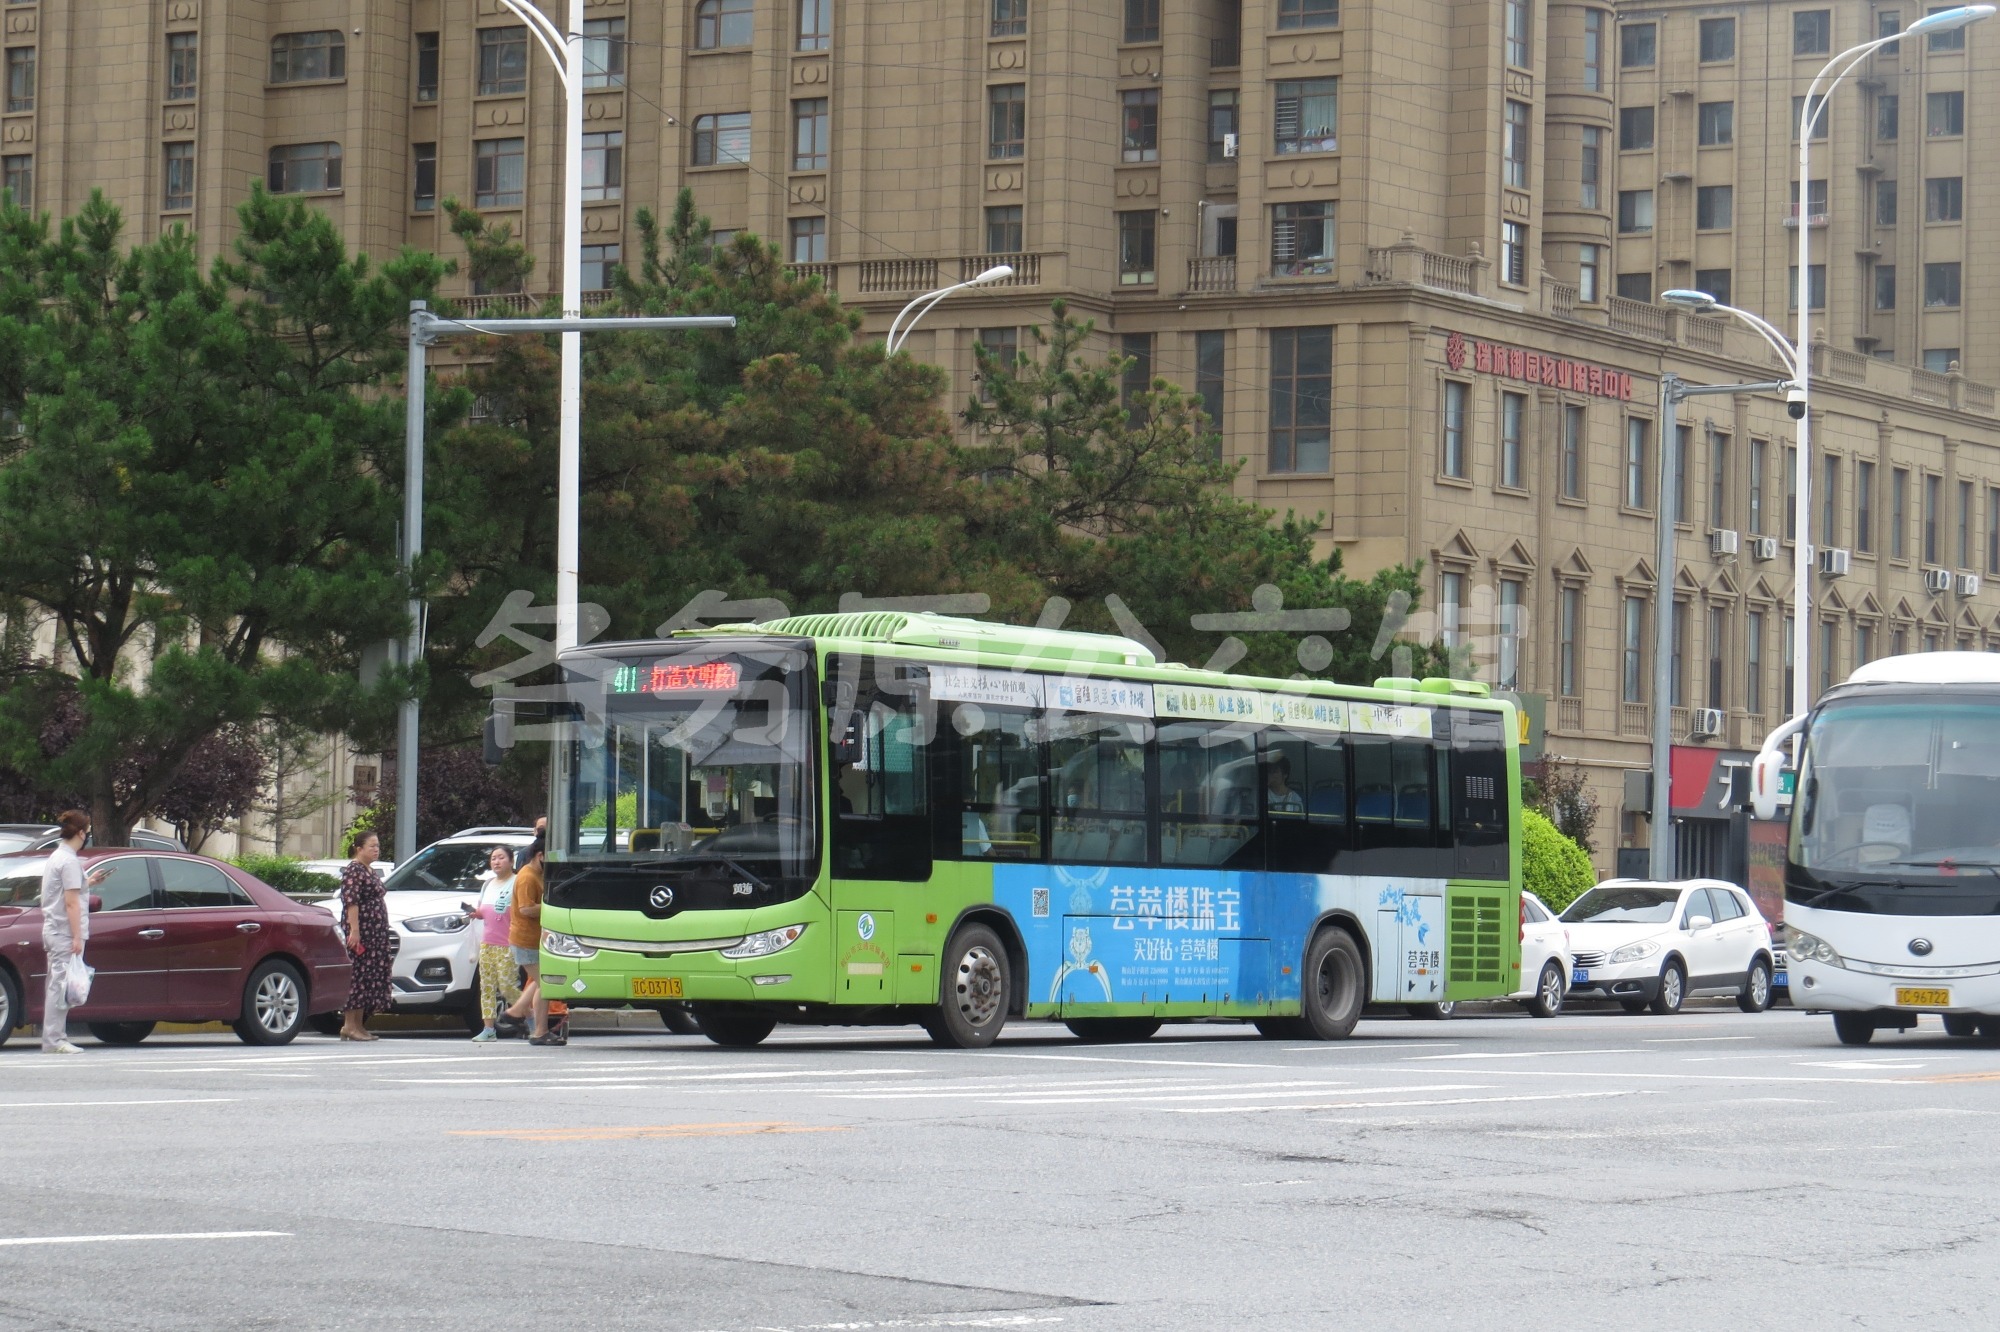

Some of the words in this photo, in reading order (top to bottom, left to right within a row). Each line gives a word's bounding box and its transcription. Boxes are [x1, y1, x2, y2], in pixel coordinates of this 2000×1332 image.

[1474, 340, 1633, 401] 瑞城御园物业服务中心
[614, 666, 637, 692] 411
[944, 674, 1027, 694] 社会主义核心价值观
[1110, 885, 1241, 931] 荟萃楼珠宝
[1408, 950, 1440, 968] 荟萃楼
